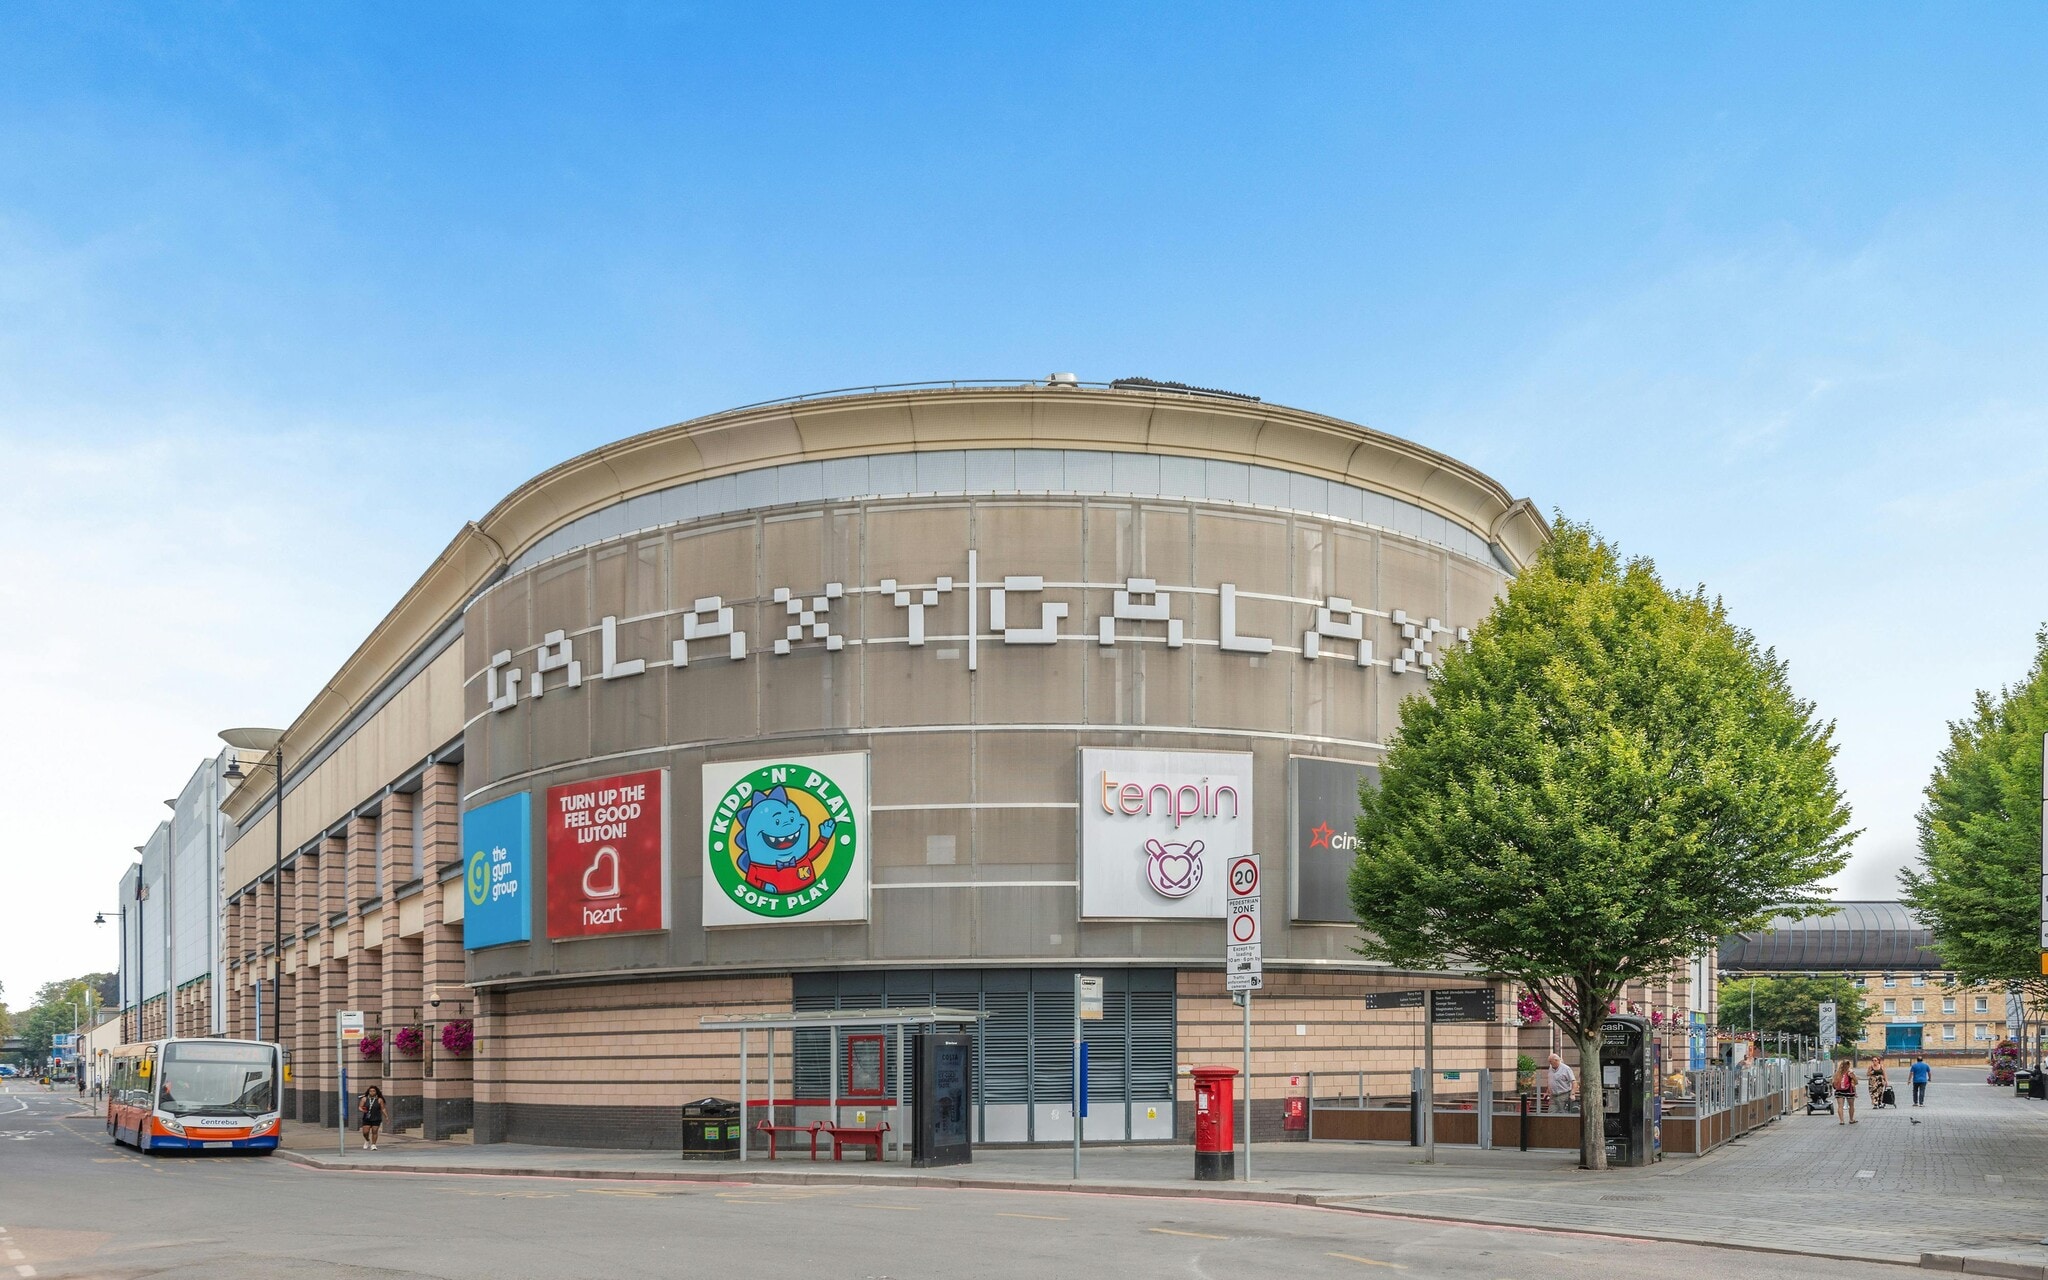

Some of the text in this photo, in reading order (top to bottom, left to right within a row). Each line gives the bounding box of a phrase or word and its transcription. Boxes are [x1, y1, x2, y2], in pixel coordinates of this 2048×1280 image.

[488, 575, 1470, 712] GALAXY GALAX
[559, 784, 645, 812] TURN UP THE
[712, 781, 753, 834] KIDD
[804, 772, 852, 824] PLAY
[1101, 769, 1238, 828] tenpin
[564, 803, 641, 829] FEEL GOOD
[577, 822, 627, 844] LUTON!
[492, 845, 507, 862] the
[492, 861, 512, 882] gym
[1235, 869, 1254, 886] 20
[492, 879, 518, 902] group
[734, 878, 830, 910] SOFT PLAY
[1230, 898, 1259, 906] PEDESTRIAN
[583, 903, 623, 926] heart
[1233, 904, 1255, 914] ZONE
[1601, 1022, 1624, 1030] cash
